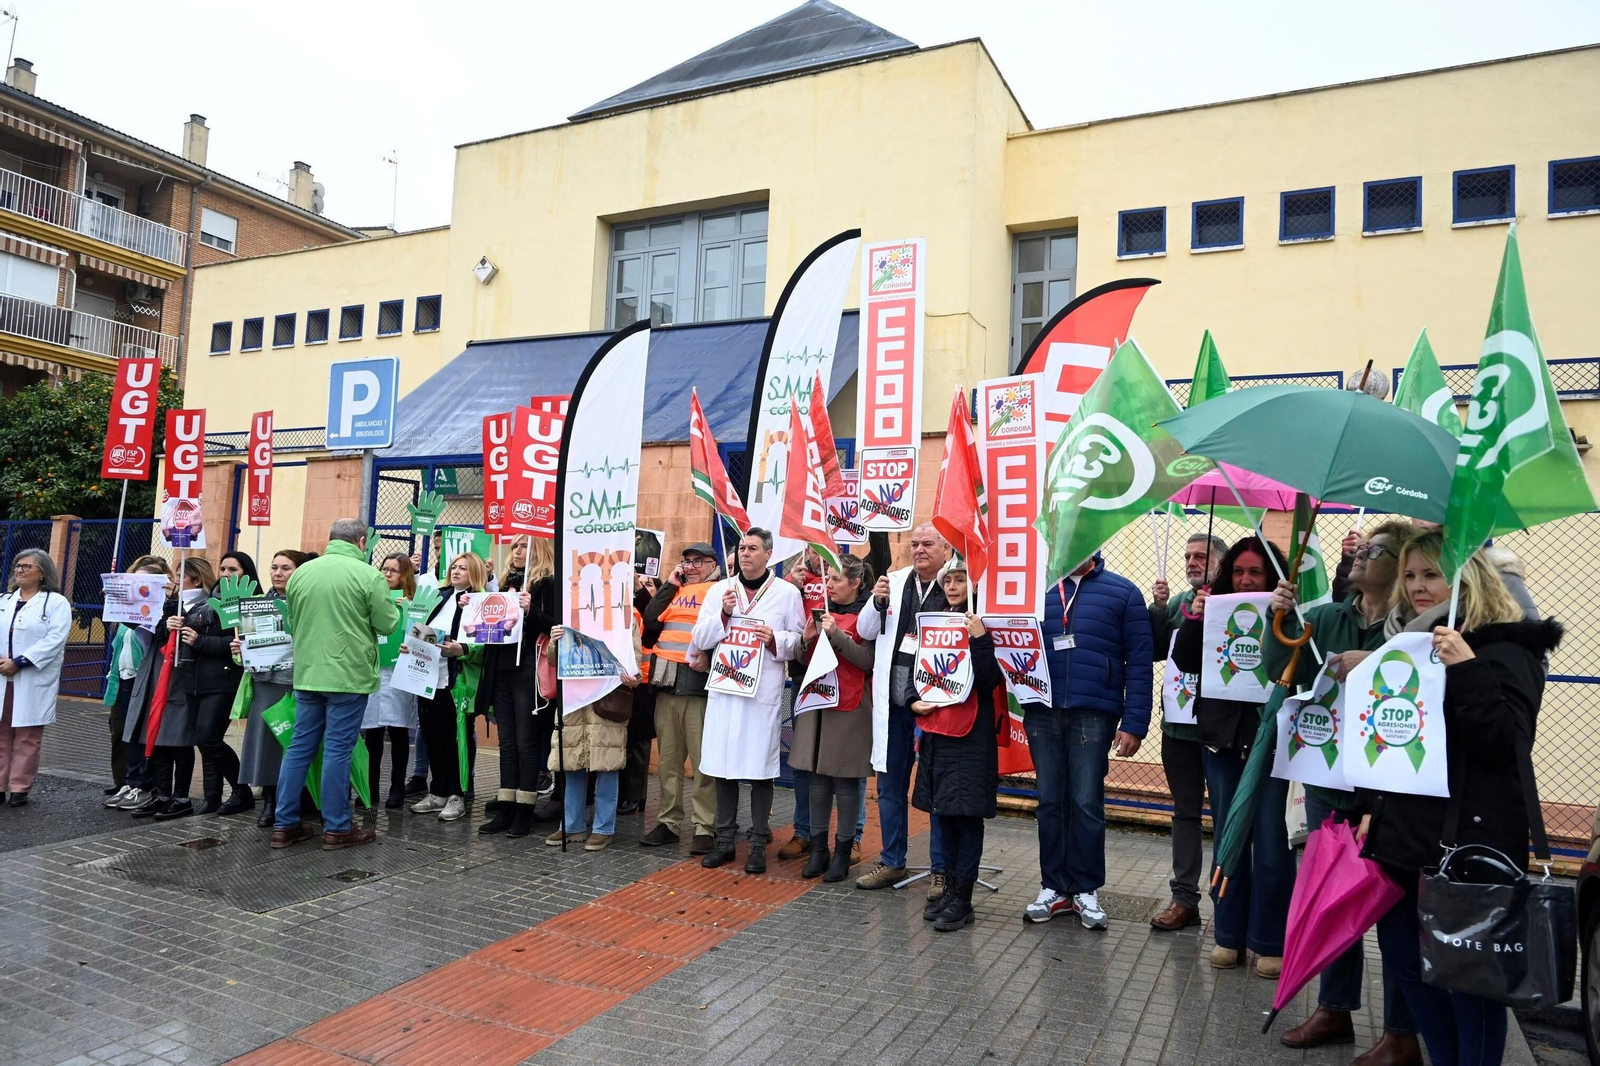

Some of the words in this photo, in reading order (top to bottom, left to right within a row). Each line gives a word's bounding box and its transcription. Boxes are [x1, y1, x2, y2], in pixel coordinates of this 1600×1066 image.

[874, 307, 906, 438] CCOO
[118, 363, 154, 444] UGT
[340, 370, 381, 438] P
[172, 415, 200, 498] UGT
[253, 416, 271, 493] UGT
[489, 418, 509, 499] UGT
[522, 414, 563, 500] UGT
[866, 462, 909, 477] STOP
[879, 483, 904, 504] NO
[1395, 486, 1429, 500] Córdoba
[537, 506, 550, 514] FSP
[569, 488, 636, 521] SMA
[840, 501, 859, 519] NO
[860, 499, 910, 521] AGRESIONES
[574, 519, 636, 534] CÓRDOBA
[827, 514, 866, 536] AGRESIONES
[996, 455, 1027, 605] CCOO
[484, 604, 504, 614] STOP
[248, 635, 286, 645] RESPETO
[924, 630, 963, 646] STOP
[991, 630, 1034, 646] STOP
[1235, 644, 1260, 653] STOP
[415, 659, 426, 668] NO
[730, 650, 751, 670] NO
[933, 653, 959, 677] NO
[1010, 652, 1037, 674] NO
[713, 661, 756, 688] AGRESIONES
[916, 669, 964, 695] AGRESIONES
[1303, 712, 1330, 726] STOP
[1381, 708, 1414, 721] STOP
[1299, 723, 1333, 733] AGRESIONES
[1377, 721, 1417, 729] AGRESIONES
[1443, 935, 1482, 950] TOTE
[1493, 943, 1523, 952] BAG
